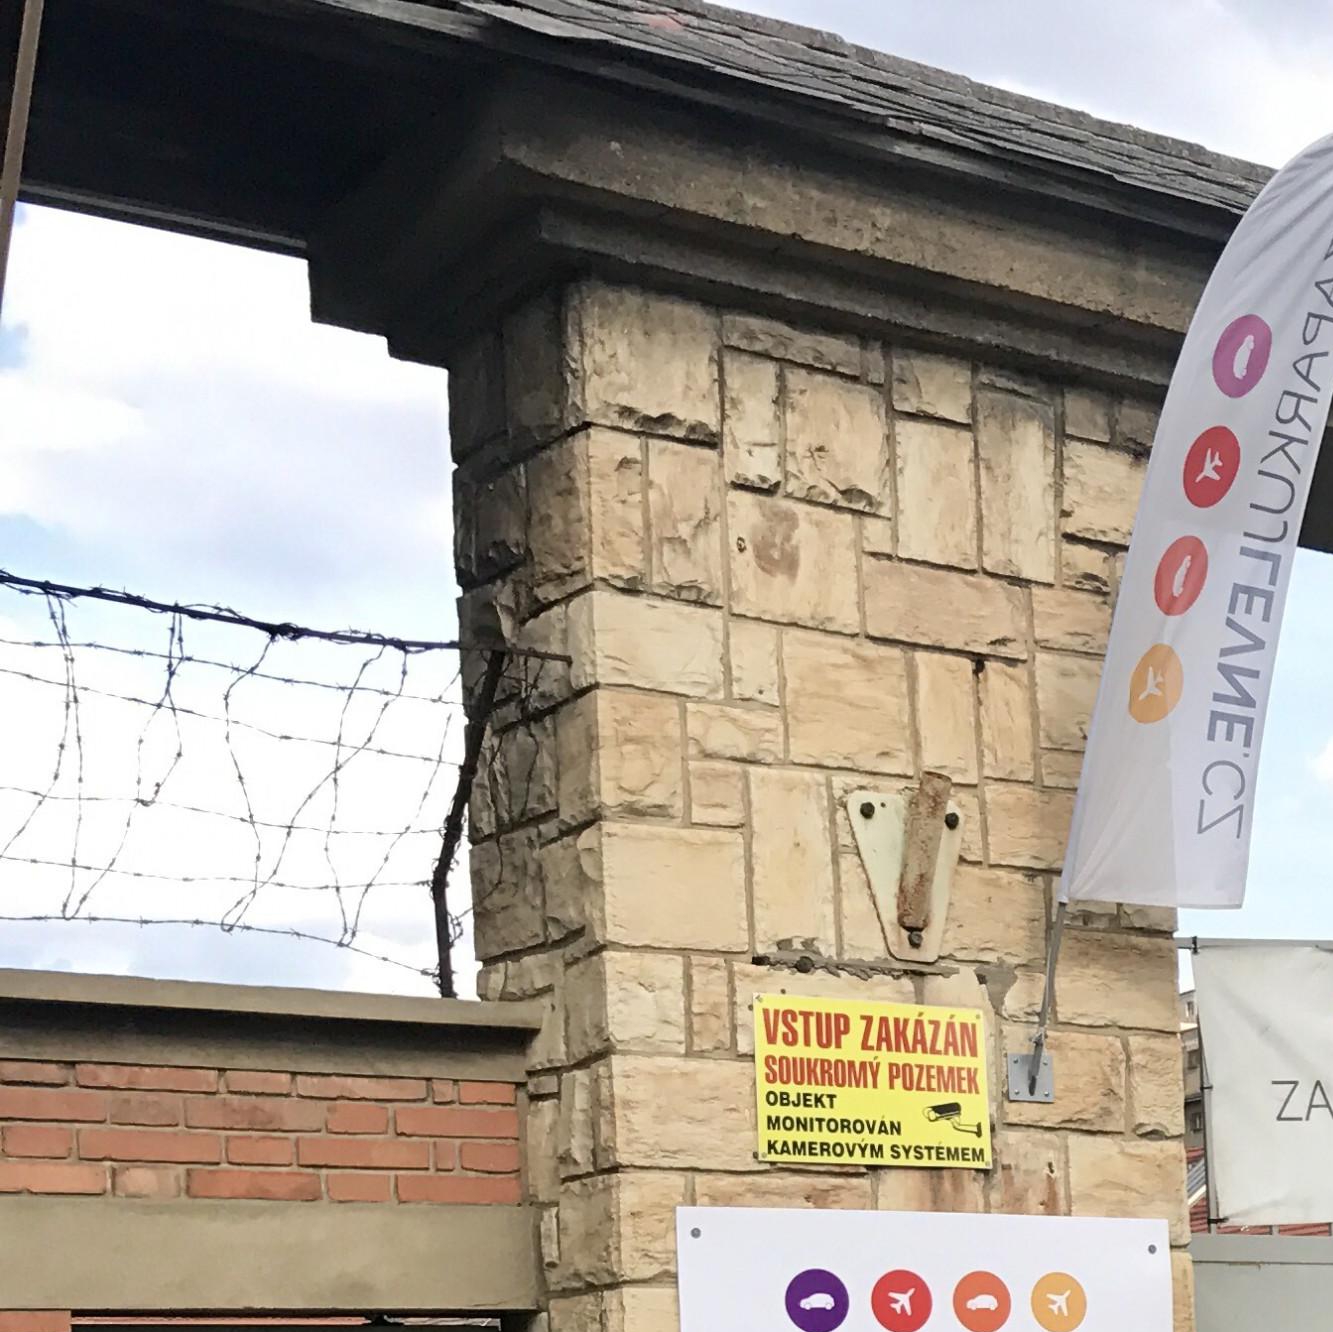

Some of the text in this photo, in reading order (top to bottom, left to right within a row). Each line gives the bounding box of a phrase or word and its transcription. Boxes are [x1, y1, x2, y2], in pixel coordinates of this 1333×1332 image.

[762, 1007, 978, 1058] VSTUP ZAKÁZÁN
[764, 1054, 981, 1095] SOUKROMÝ POZEMEK
[765, 1091, 837, 1109] OBJEKT
[766, 1114, 902, 1136] MONITOROVÁN
[767, 1138, 986, 1162] KAMEROVÝM SYSTÉMEM
